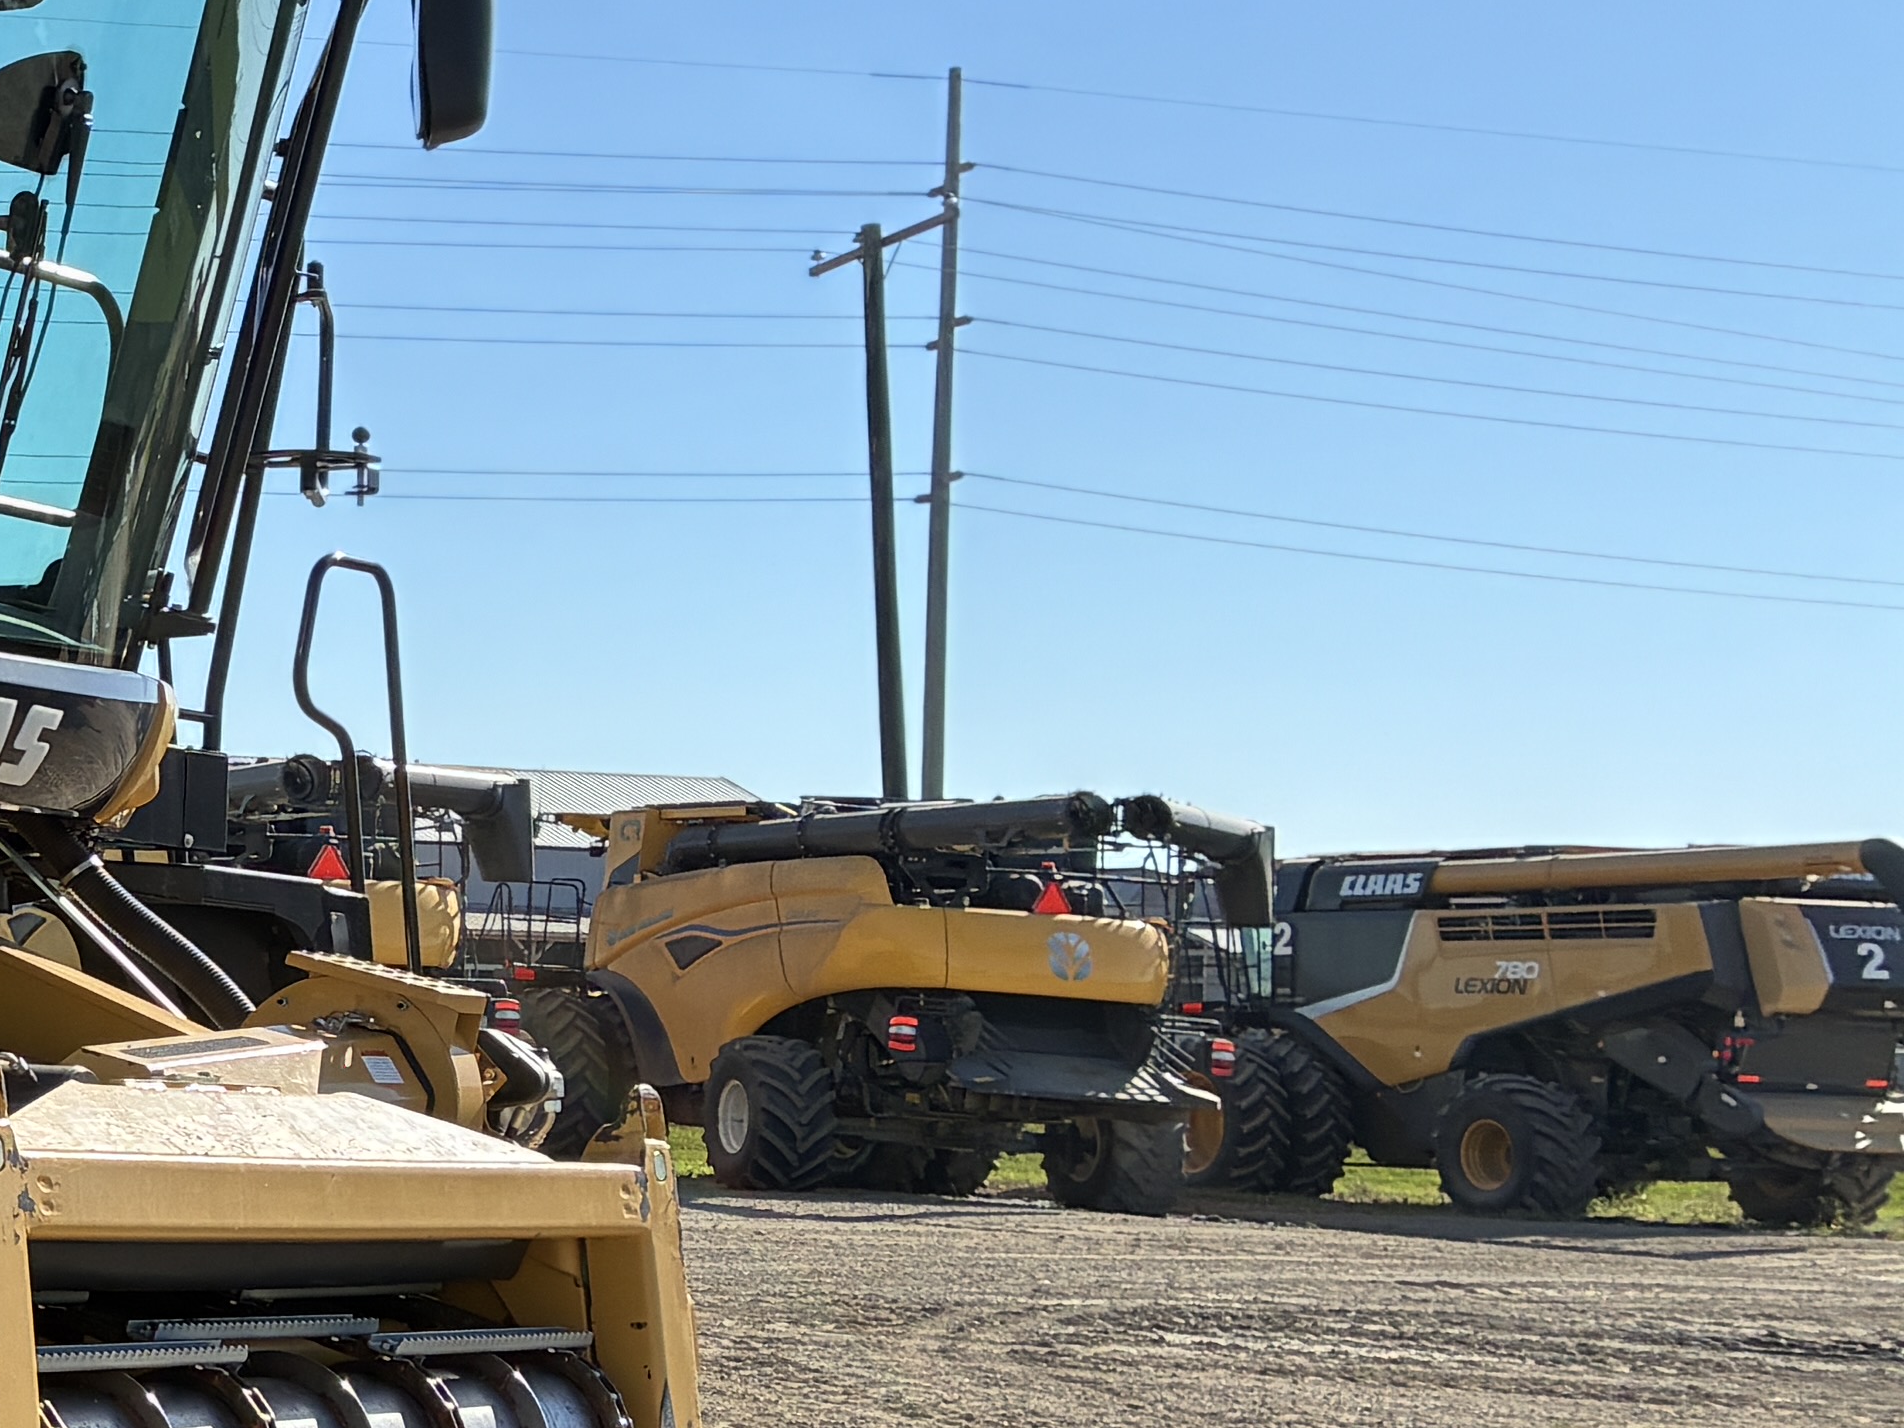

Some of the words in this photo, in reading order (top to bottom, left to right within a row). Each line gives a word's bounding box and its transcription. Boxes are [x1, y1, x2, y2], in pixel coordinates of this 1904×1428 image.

[1339, 873, 1423, 896] CLAAS
[1273, 922, 1292, 955] 2
[1829, 924, 1901, 941] LEXION
[1494, 961, 1539, 979] 780
[1857, 942, 1890, 979] 2
[1454, 977, 1528, 996] LEXION
